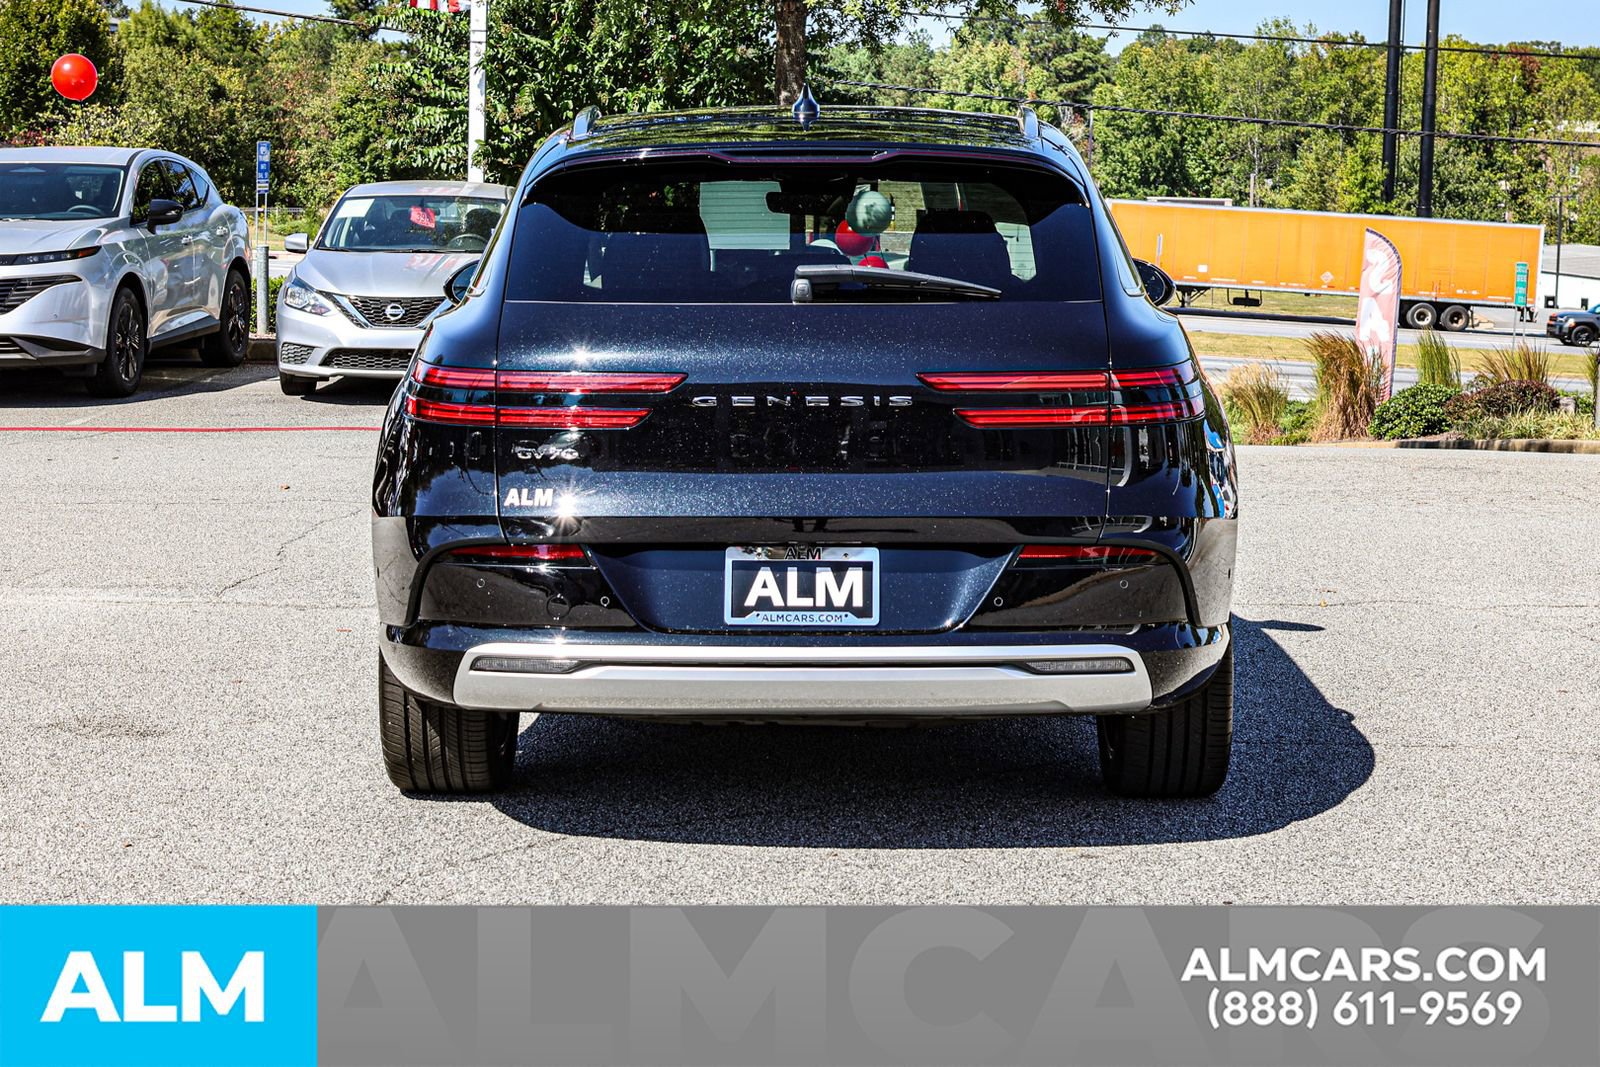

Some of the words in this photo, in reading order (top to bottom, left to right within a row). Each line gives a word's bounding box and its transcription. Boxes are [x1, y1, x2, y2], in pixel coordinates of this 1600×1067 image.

[692, 395, 913, 407] GENESIS
[503, 487, 554, 507] ALM
[784, 546, 823, 560] ALM
[743, 566, 864, 607] ALM
[761, 613, 843, 623] ALMCARS.COM
